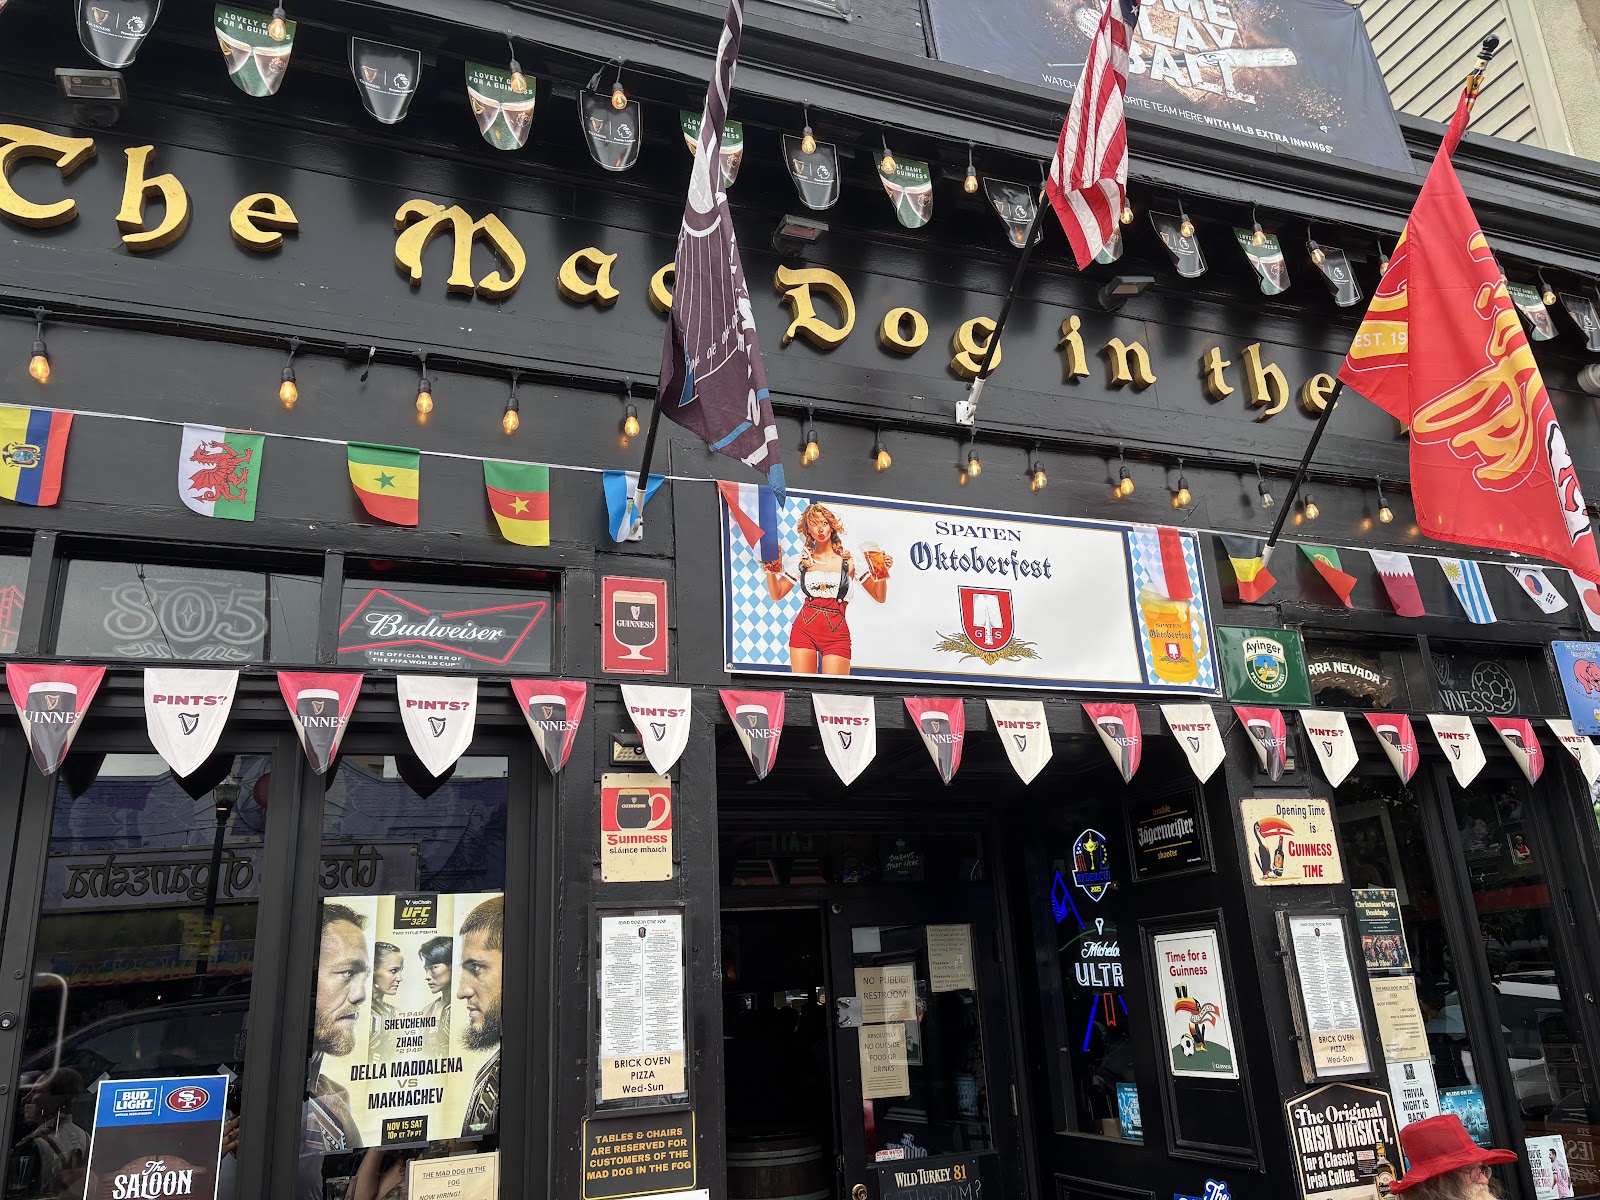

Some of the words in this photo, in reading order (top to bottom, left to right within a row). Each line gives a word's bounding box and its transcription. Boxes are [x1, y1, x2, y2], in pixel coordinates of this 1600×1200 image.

[217, 17, 235, 28] FOR
[225, 12, 259, 26] LOVELY
[469, 76, 484, 86] FOR
[475, 71, 504, 83] LOVELY
[1042, 73, 1077, 90] WATCH
[1150, 101, 1178, 117] TEAM
[1179, 109, 1203, 123] HERE
[1203, 115, 1231, 130] WITH
[1232, 122, 1255, 136] MLB
[1256, 128, 1289, 144] EXTRA
[1290, 136, 1334, 154] INNINGS
[773, 263, 1003, 381] Dog
[1060, 315, 1158, 391] in
[1203, 341, 1345, 422] the
[935, 520, 1022, 543] SPATEN
[910, 540, 1053, 581] Oktoberfest
[103, 581, 269, 646] 805
[365, 612, 504, 642] Budweiser
[616, 619, 655, 629] GUINNESS
[974, 629, 983, 638] G
[994, 631, 1002, 639] S
[1150, 629, 1192, 640] Oktoberfest
[1246, 640, 1282, 655] Ayinger
[387, 652, 426, 660] OFFICIAL
[1308, 661, 1332, 676] RRA
[1332, 661, 1381, 684] NEVADA
[152, 694, 228, 706] PINTS?
[406, 699, 471, 711] PINTS?
[630, 706, 687, 718] PINTS?
[820, 715, 870, 726] PINTS?
[996, 720, 1041, 730] PINTS?
[1170, 723, 1212, 732] PINTS?
[1309, 727, 1345, 737] PINTS?
[1437, 731, 1471, 741] PINTS?
[1276, 804, 1307, 820] Opening
[1307, 804, 1326, 816] Time
[1309, 822, 1317, 834] is
[1288, 840, 1333, 857] GUINNESS
[1302, 864, 1324, 878] TIME
[1090, 885, 1102, 893] 2025
[1381, 900, 1396, 909] Party
[402, 906, 432, 918] UFC
[1365, 909, 1389, 917] Bookings
[410, 917, 428, 926] 322
[1165, 951, 1186, 963] Time
[1187, 949, 1201, 962] for
[1201, 951, 1207, 961] a
[1169, 965, 1208, 977] Guinness
[863, 976, 875, 985] NO
[879, 975, 907, 985] PUBLIC
[863, 990, 907, 1000] RESTROOM
[384, 1016, 436, 1031] SHEVCHENKO
[396, 1035, 423, 1049] ZHANG
[1318, 1034, 1337, 1044] BRICK
[1337, 1034, 1355, 1042] OVEN
[864, 1042, 874, 1050] NO
[875, 1041, 901, 1050] OUTSIDE
[1330, 1045, 1347, 1053] PIZZA
[614, 1058, 642, 1069] BRICK
[644, 1056, 671, 1066] OVEN
[869, 1053, 887, 1061] FOOD
[1326, 1055, 1354, 1064] Wed-Sun
[350, 1062, 387, 1081] DELLA
[390, 1056, 463, 1078] MADDALENA
[873, 1064, 895, 1073] DRINKS
[630, 1070, 656, 1081] PIZZA
[397, 1078, 419, 1088] VS
[622, 1083, 664, 1094] Wed-Sun
[122, 1090, 149, 1101] BUD
[368, 1087, 444, 1110] MAKHACHEV
[1402, 1087, 1425, 1100] TRIVIA
[116, 1098, 154, 1111] LIGHT
[1402, 1099, 1421, 1112] NIGHT
[1422, 1098, 1430, 1109] IS
[1295, 1103, 1325, 1126] The
[1325, 1100, 1383, 1126] Original
[1407, 1111, 1427, 1123] BACK!
[386, 1121, 401, 1131] NOV
[401, 1121, 409, 1130] 15
[410, 1119, 423, 1128] SAT
[595, 1132, 634, 1144] TABLES
[636, 1131, 645, 1140] &
[646, 1127, 683, 1139] CHAIRS
[1297, 1124, 1334, 1154] IRISH
[1333, 1117, 1394, 1149] WHISKEY,
[590, 1145, 612, 1157] ARE
[613, 1140, 665, 1154] RESERVED
[667, 1138, 688, 1148] FOR
[589, 1153, 651, 1168] CUSTOMERS
[653, 1152, 667, 1161] OF
[669, 1149, 689, 1160] THE
[1303, 1155, 1317, 1172] for
[1318, 1156, 1325, 1169] a
[1324, 1149, 1356, 1169] Classic
[142, 1160, 167, 1176] The
[435, 1169, 451, 1177] MAD
[451, 1168, 466, 1176] DOG
[466, 1166, 474, 1174] IN
[586, 1169, 609, 1181] MAD
[611, 1166, 633, 1178] DOG
[635, 1165, 647, 1175] IN
[648, 1163, 669, 1173] THE
[671, 1160, 692, 1171] FOG
[894, 1171, 918, 1188] WILD
[916, 1167, 951, 1185] TURKEY
[953, 1163, 967, 1180] 81
[1306, 1170, 1328, 1190] Irish
[1328, 1168, 1360, 1186] Coffee.
[112, 1169, 194, 1200] SALOON
[436, 1190, 461, 1199] HIRING!
